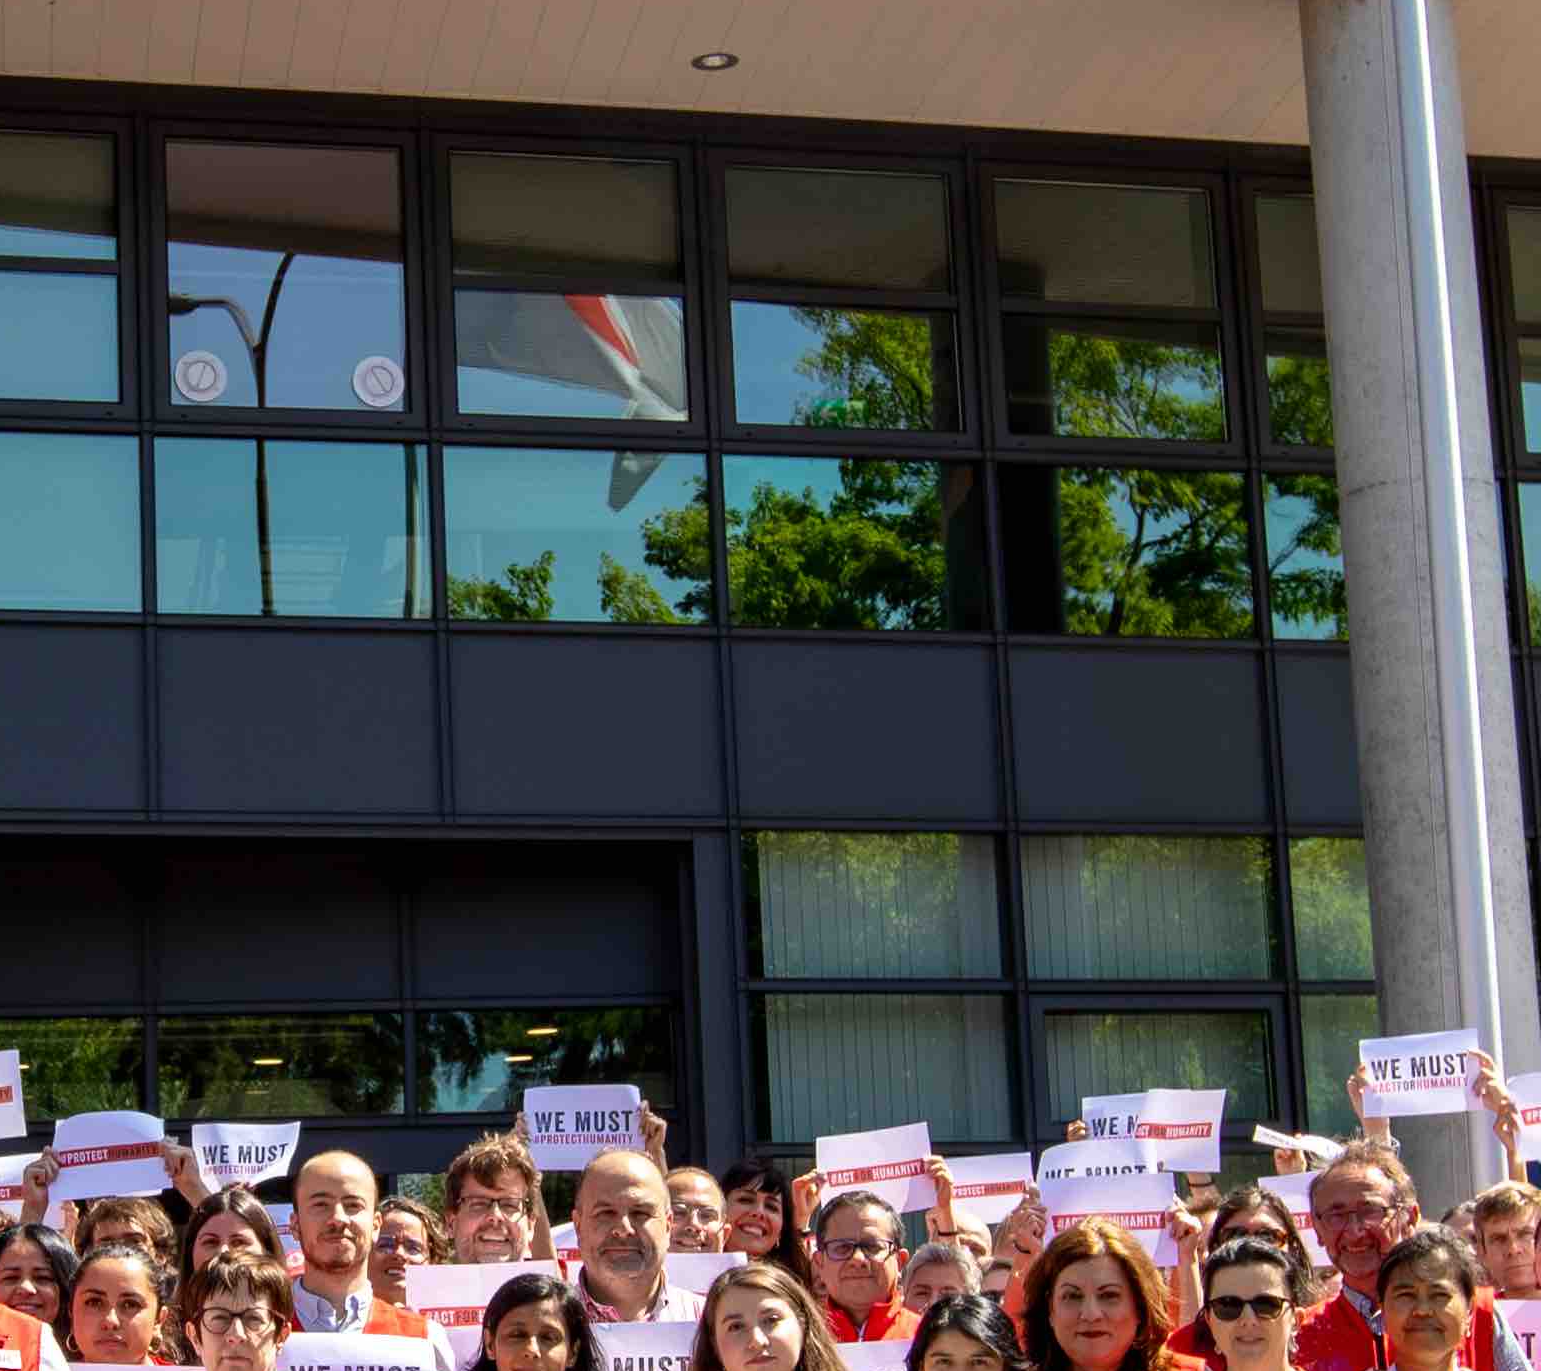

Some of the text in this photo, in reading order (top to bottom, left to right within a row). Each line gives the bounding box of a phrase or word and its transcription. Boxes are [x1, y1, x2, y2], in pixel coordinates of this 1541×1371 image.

[1372, 1052, 1468, 1080] WE MUST
[535, 1110, 633, 1133] WE MUST
[1092, 1116, 1118, 1136] WE
[534, 1133, 633, 1145] #PROTECTHUMANITY
[203, 1143, 289, 1166] WE MUST
